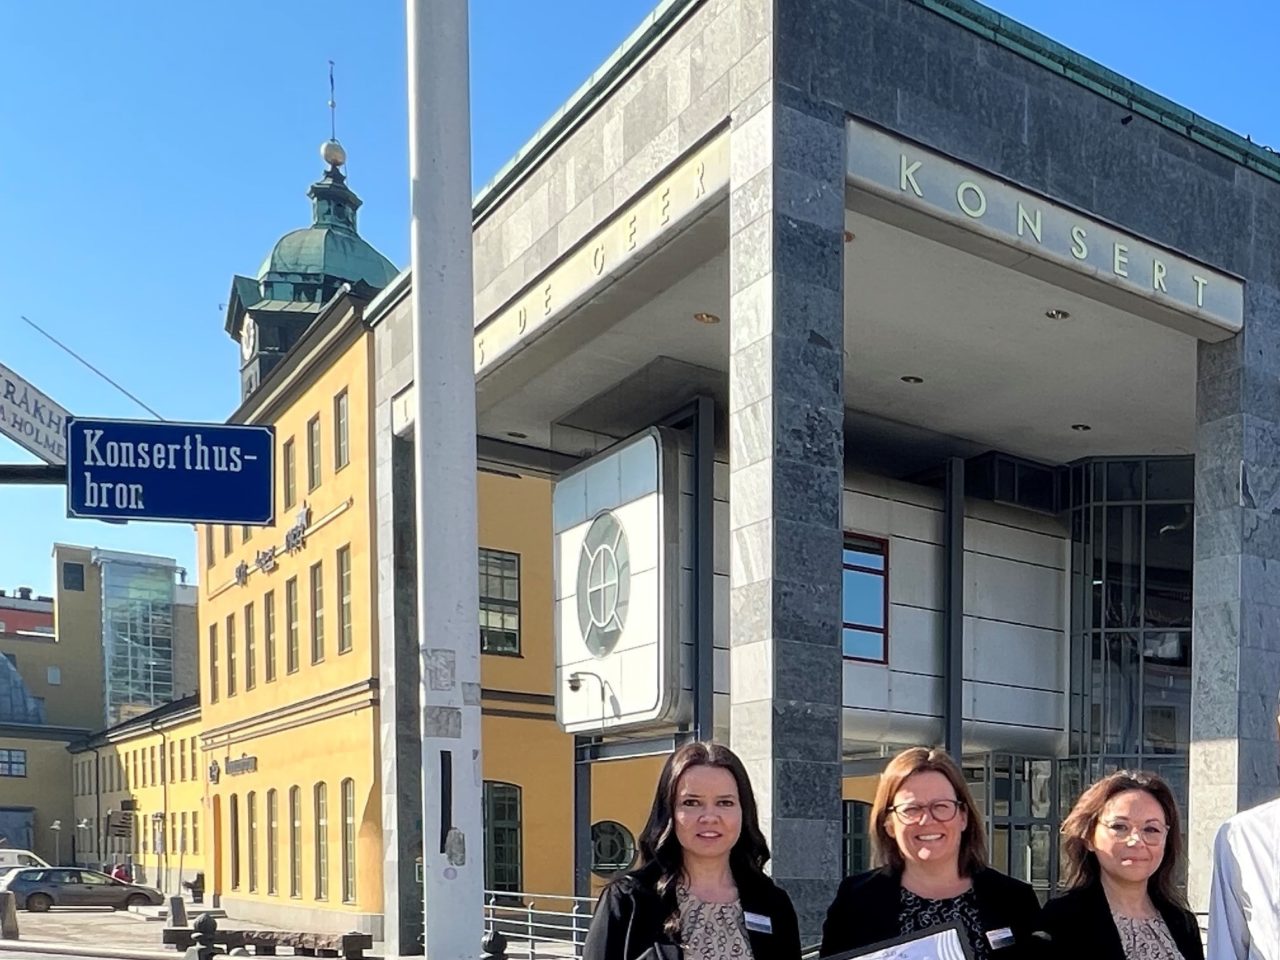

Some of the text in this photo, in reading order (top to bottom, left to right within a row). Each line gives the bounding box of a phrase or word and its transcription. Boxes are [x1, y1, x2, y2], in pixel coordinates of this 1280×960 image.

[517, 161, 706, 335] DE GEER
[899, 154, 1209, 307] KONSERT
[83, 429, 258, 473] Konserthus-
[84, 472, 145, 510] bron
